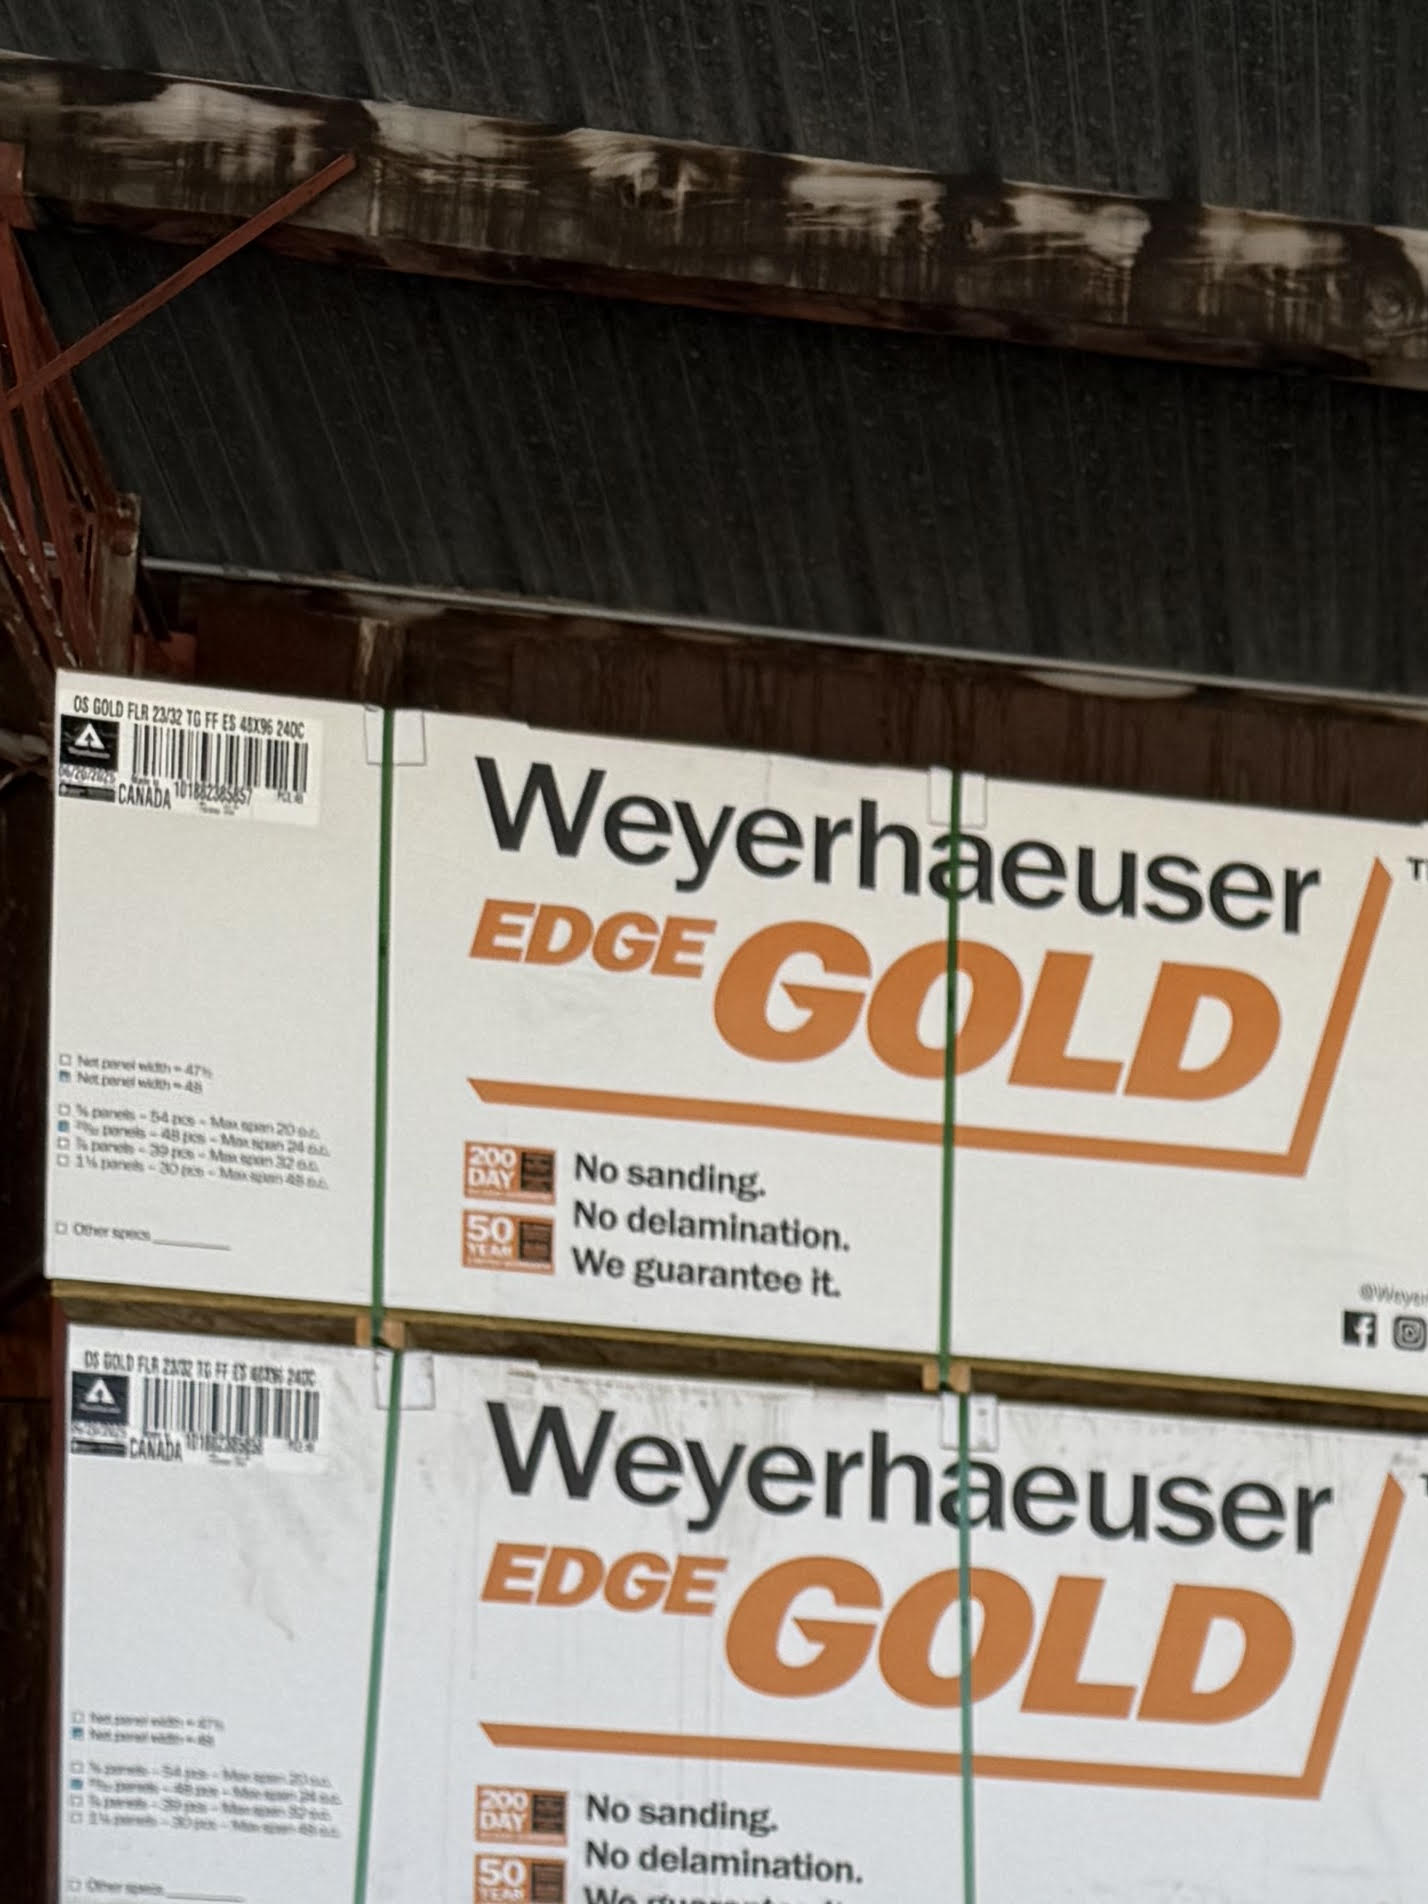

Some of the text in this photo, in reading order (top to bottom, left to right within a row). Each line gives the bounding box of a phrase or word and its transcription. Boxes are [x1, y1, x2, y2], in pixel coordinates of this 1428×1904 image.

[92, 697, 123, 718] GOLD
[128, 701, 149, 722] FLR
[187, 709, 202, 726] TG
[205, 711, 219, 730] FF
[222, 714, 236, 732] ES
[118, 783, 172, 810] CANADA
[474, 756, 1320, 934] Weyerhaeuser
[470, 899, 1280, 1099] EDGE GOLD
[467, 1168, 515, 1189] DAY
[468, 1146, 516, 1168] 200
[575, 1153, 765, 1201] No sanding.
[466, 1215, 514, 1243] 50
[574, 1200, 849, 1251] No delamination.
[572, 1247, 839, 1297] We guarantee it.
[484, 1397, 1333, 1554] Weyerhaeuser
[482, 1542, 1294, 1723] EDGE GOLD
[479, 1811, 527, 1831] DAY
[480, 1790, 528, 1811] 200
[586, 1793, 777, 1838] No sanding.
[478, 1859, 526, 1886] 50
[586, 1840, 862, 1884] No delamination.
